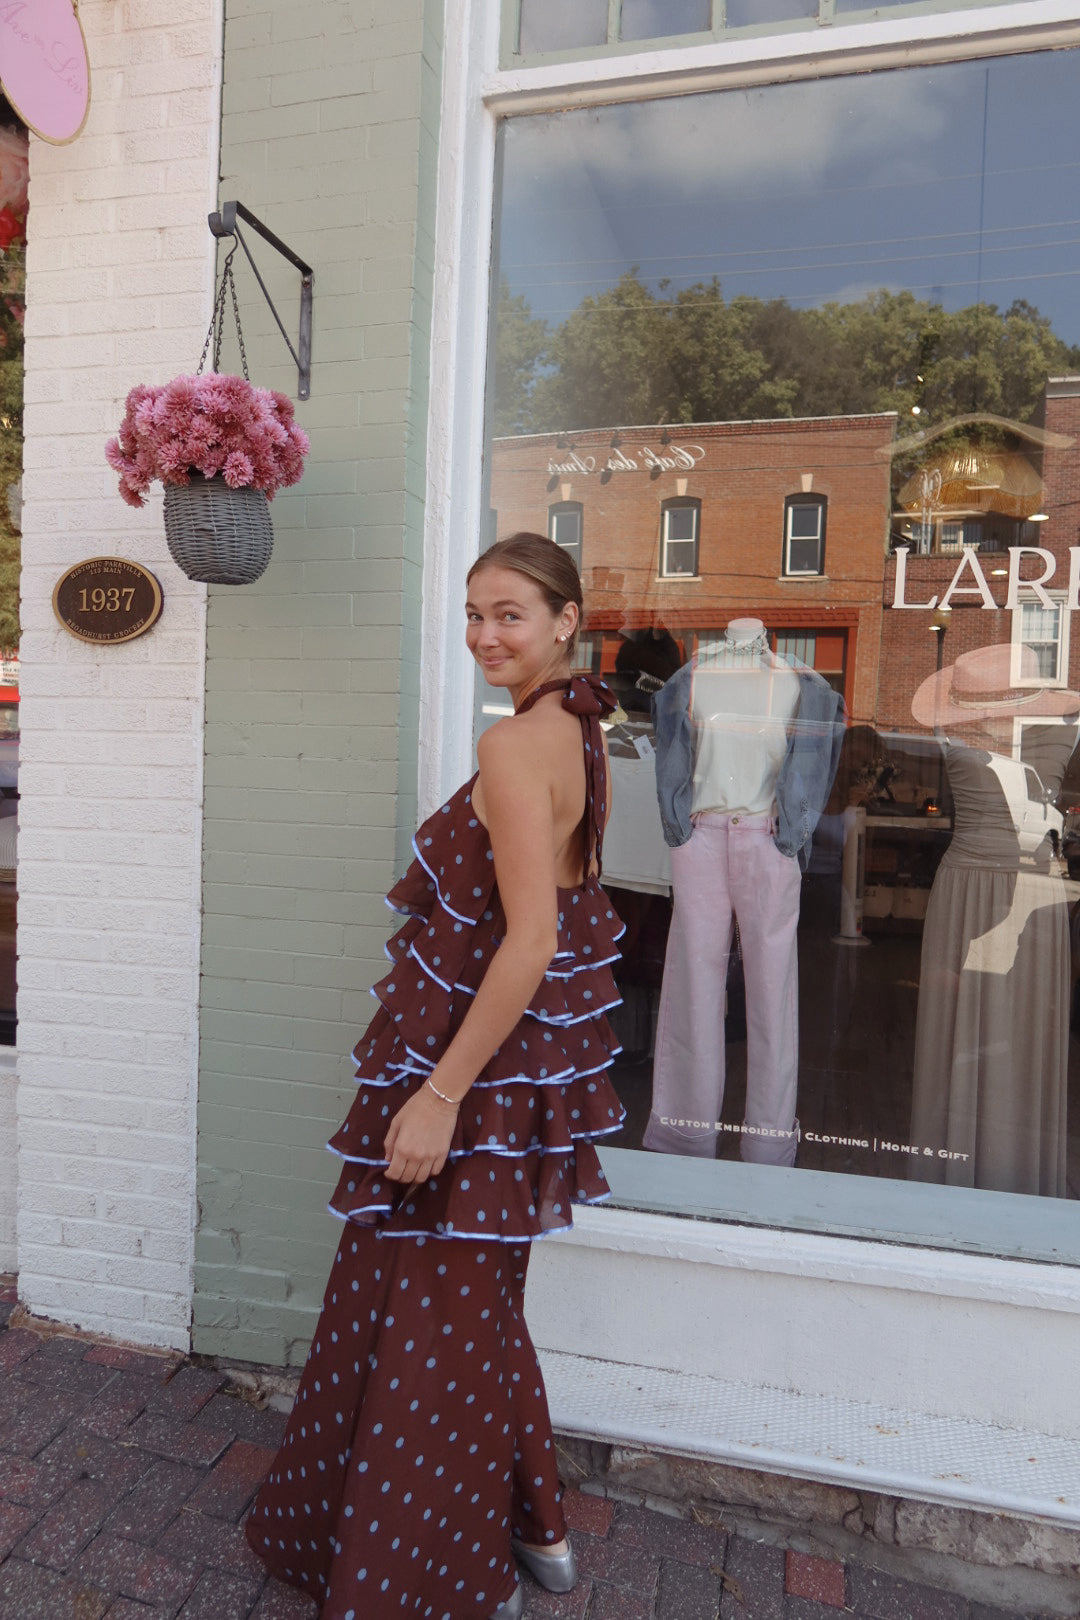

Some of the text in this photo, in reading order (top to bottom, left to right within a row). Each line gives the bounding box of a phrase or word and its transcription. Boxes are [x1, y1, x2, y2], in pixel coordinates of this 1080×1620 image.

[70, 561, 143, 579] HISTORIC PARKVILLE
[79, 588, 135, 612] 1937
[114, 618, 144, 638] GROCERY
[923, 1147, 934, 1157] &
